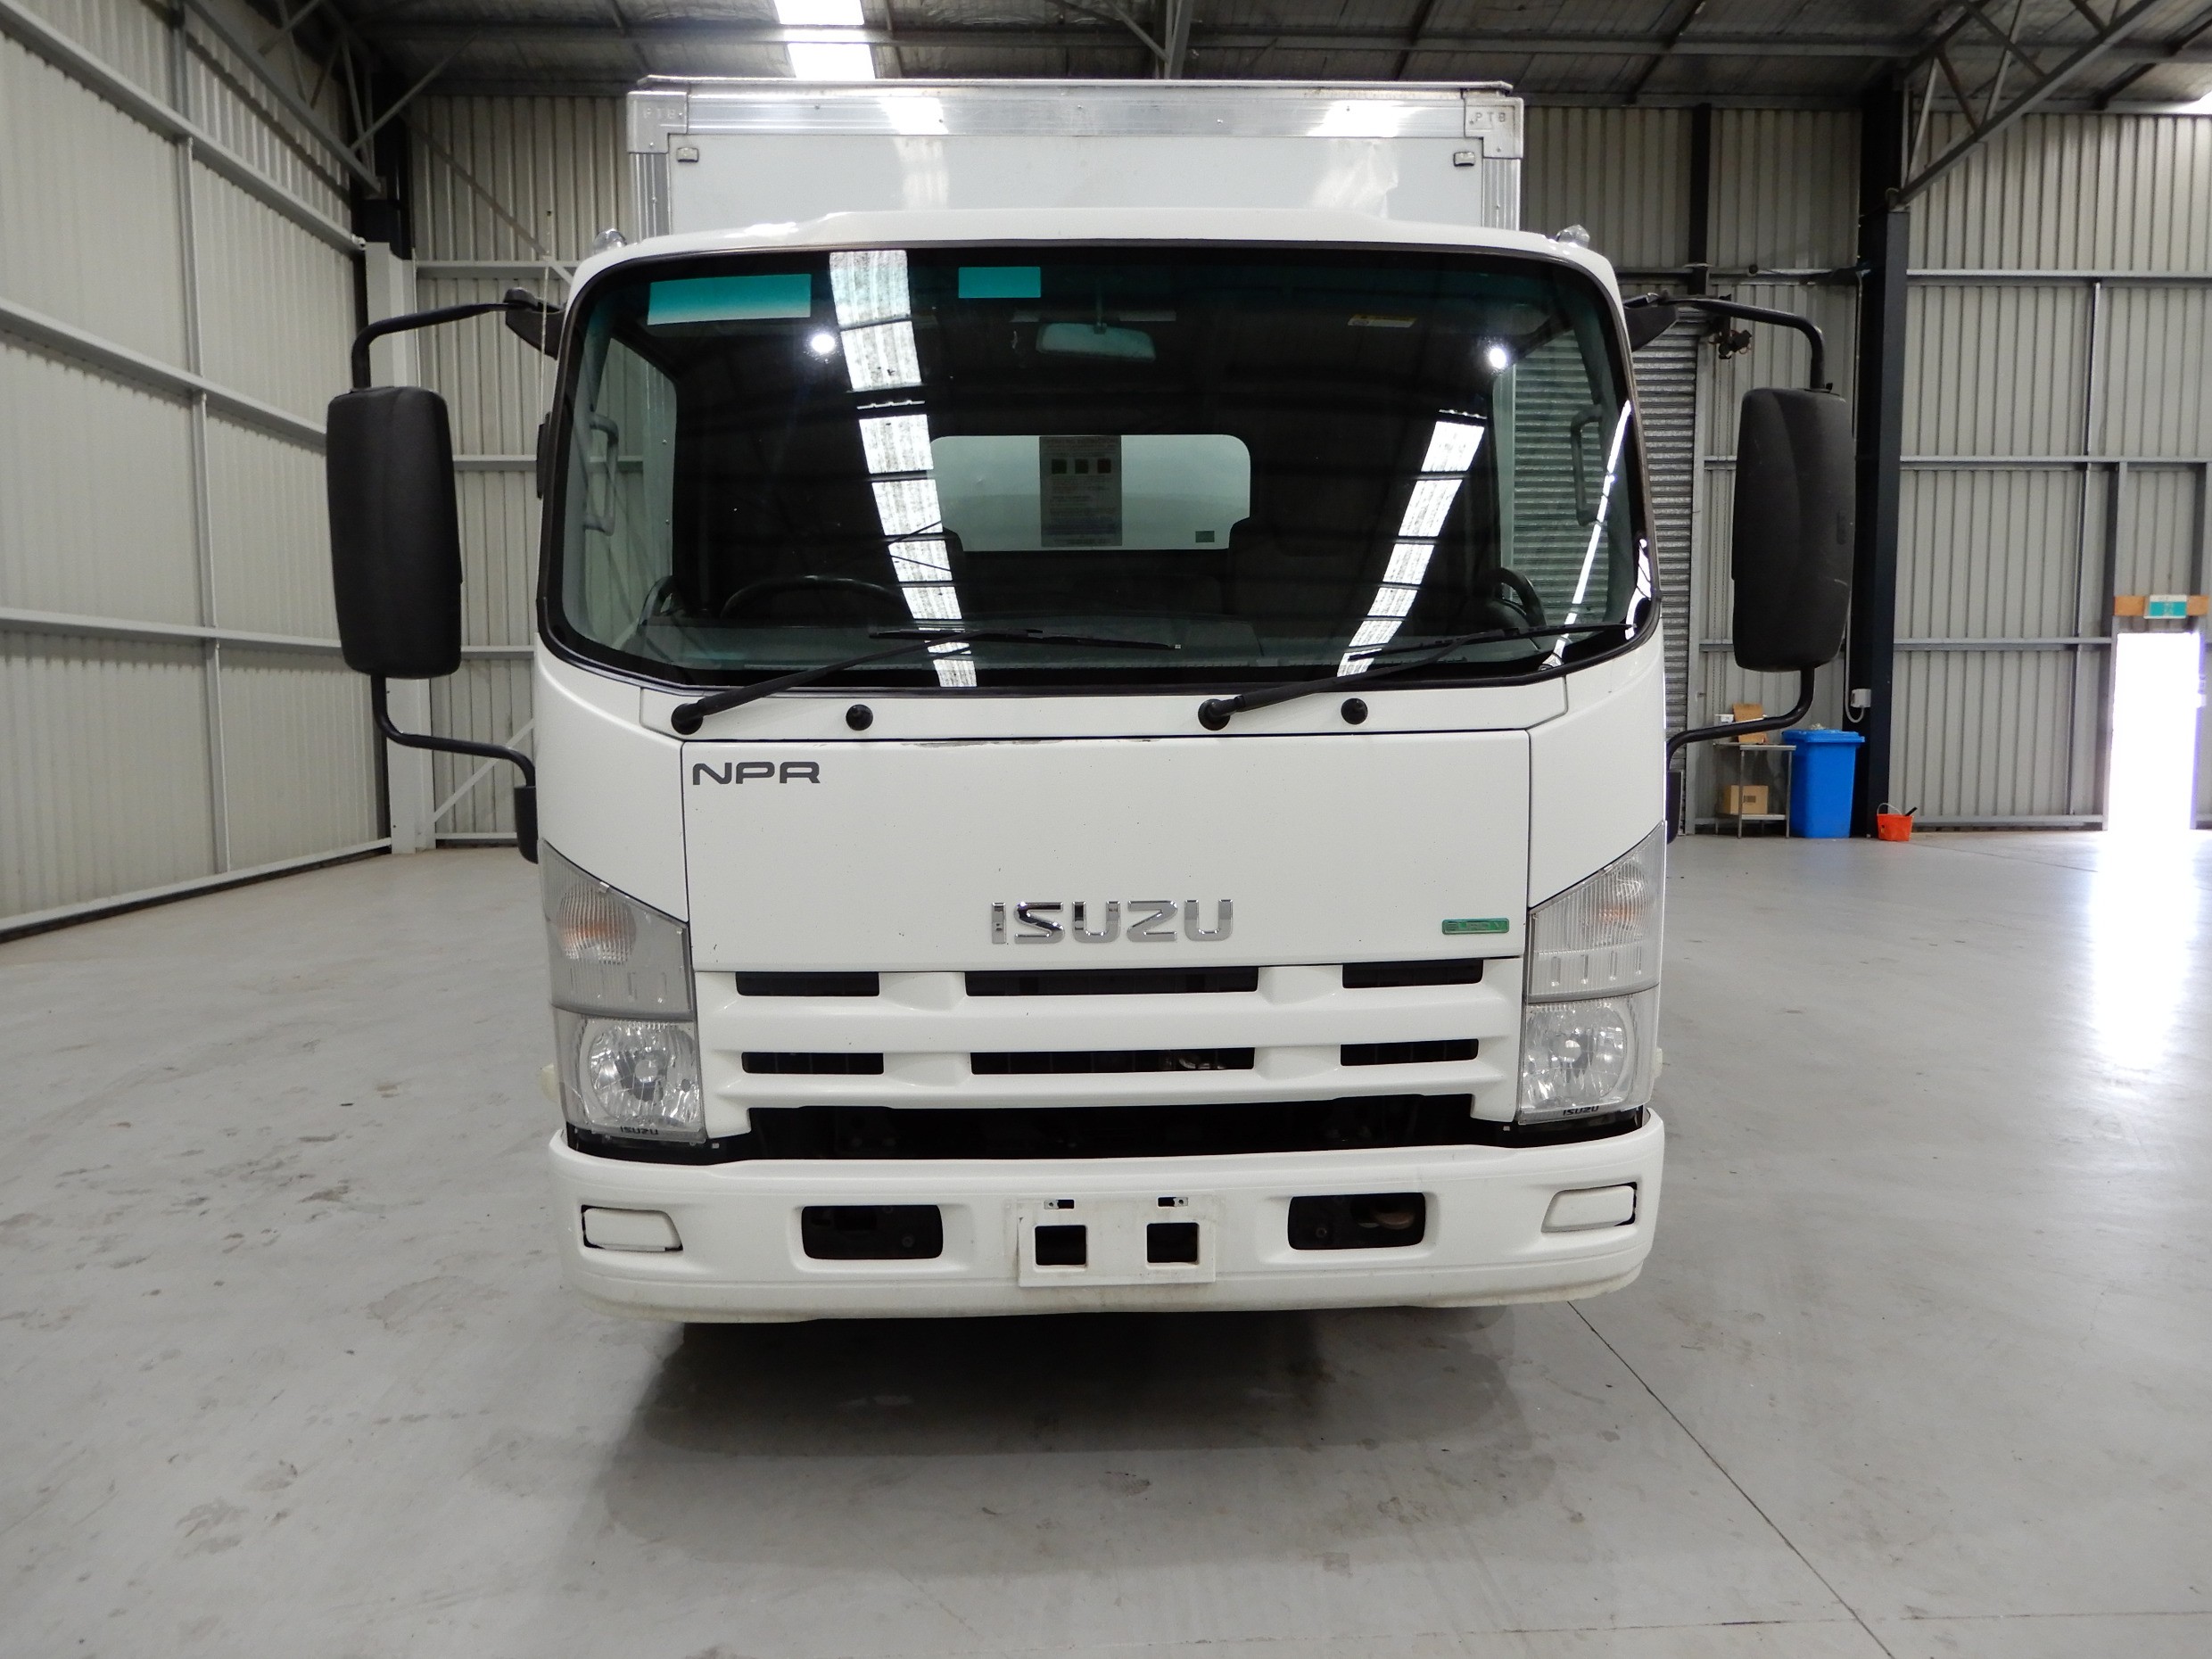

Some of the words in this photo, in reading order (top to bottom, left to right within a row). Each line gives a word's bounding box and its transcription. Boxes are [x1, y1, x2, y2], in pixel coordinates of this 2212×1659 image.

[1474, 111, 1506, 123] PTB
[692, 761, 821, 786] NPR
[991, 899, 1234, 944] ISUZU
[1563, 1105, 1599, 1116] ISUZU
[620, 1126, 659, 1135] ISUZU
